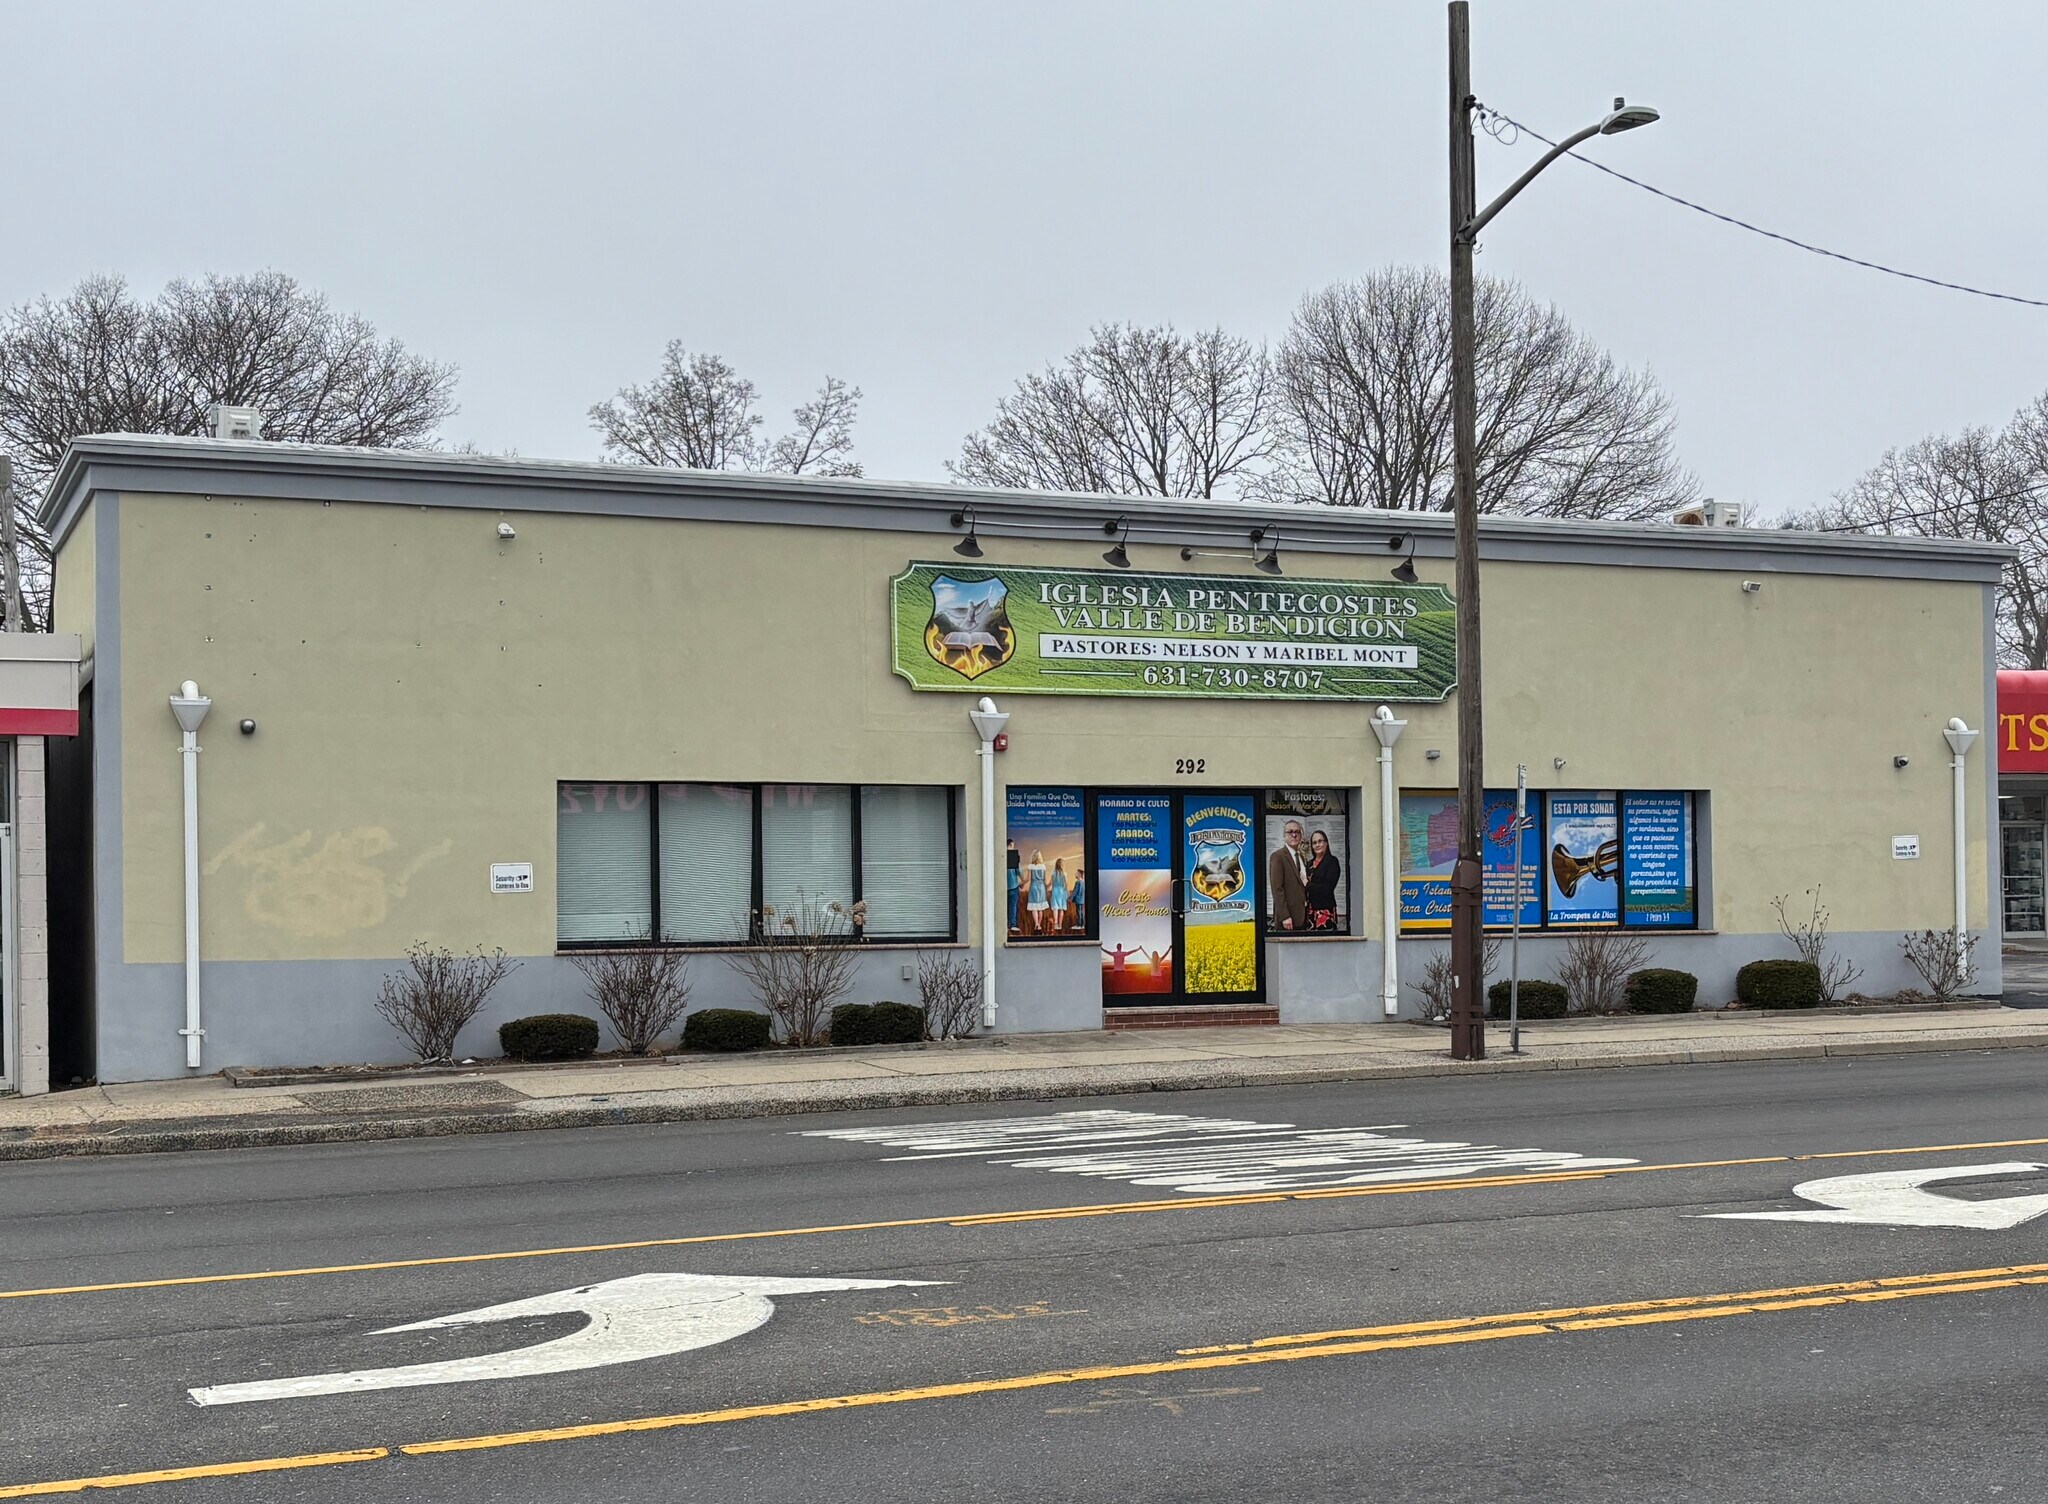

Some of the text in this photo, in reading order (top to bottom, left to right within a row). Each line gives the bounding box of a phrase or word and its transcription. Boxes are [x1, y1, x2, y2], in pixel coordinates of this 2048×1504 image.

[1038, 582, 1418, 618] IGLESIA PENTECOSTES
[1051, 606, 1407, 640] VALLE DE BENDICION
[1052, 639, 1407, 663] PASTORES: NELSON Y MARIBEL MONT
[1143, 666, 1324, 690] 631-730-8707
[1175, 758, 1206, 775] 292
[1023, 792, 1047, 800] Familia
[1284, 790, 1325, 802] Pastores:
[1007, 800, 1081, 808] Unida Permanece Unida
[1099, 800, 1170, 808] HORARIO DE CULTO
[1553, 802, 1615, 815] ESTA POR SONAR
[1116, 812, 1152, 822] MARTES:
[1185, 806, 1252, 828] BIENVENIDOS
[1115, 829, 1154, 838] SABADO:
[1111, 847, 1158, 857] DOMINGO:
[1118, 888, 1152, 906] Cristo
[1101, 903, 1170, 918] Viene Pronto
[1425, 899, 1452, 915] Crist
[1550, 910, 1617, 921] La Trompeta de Dios
